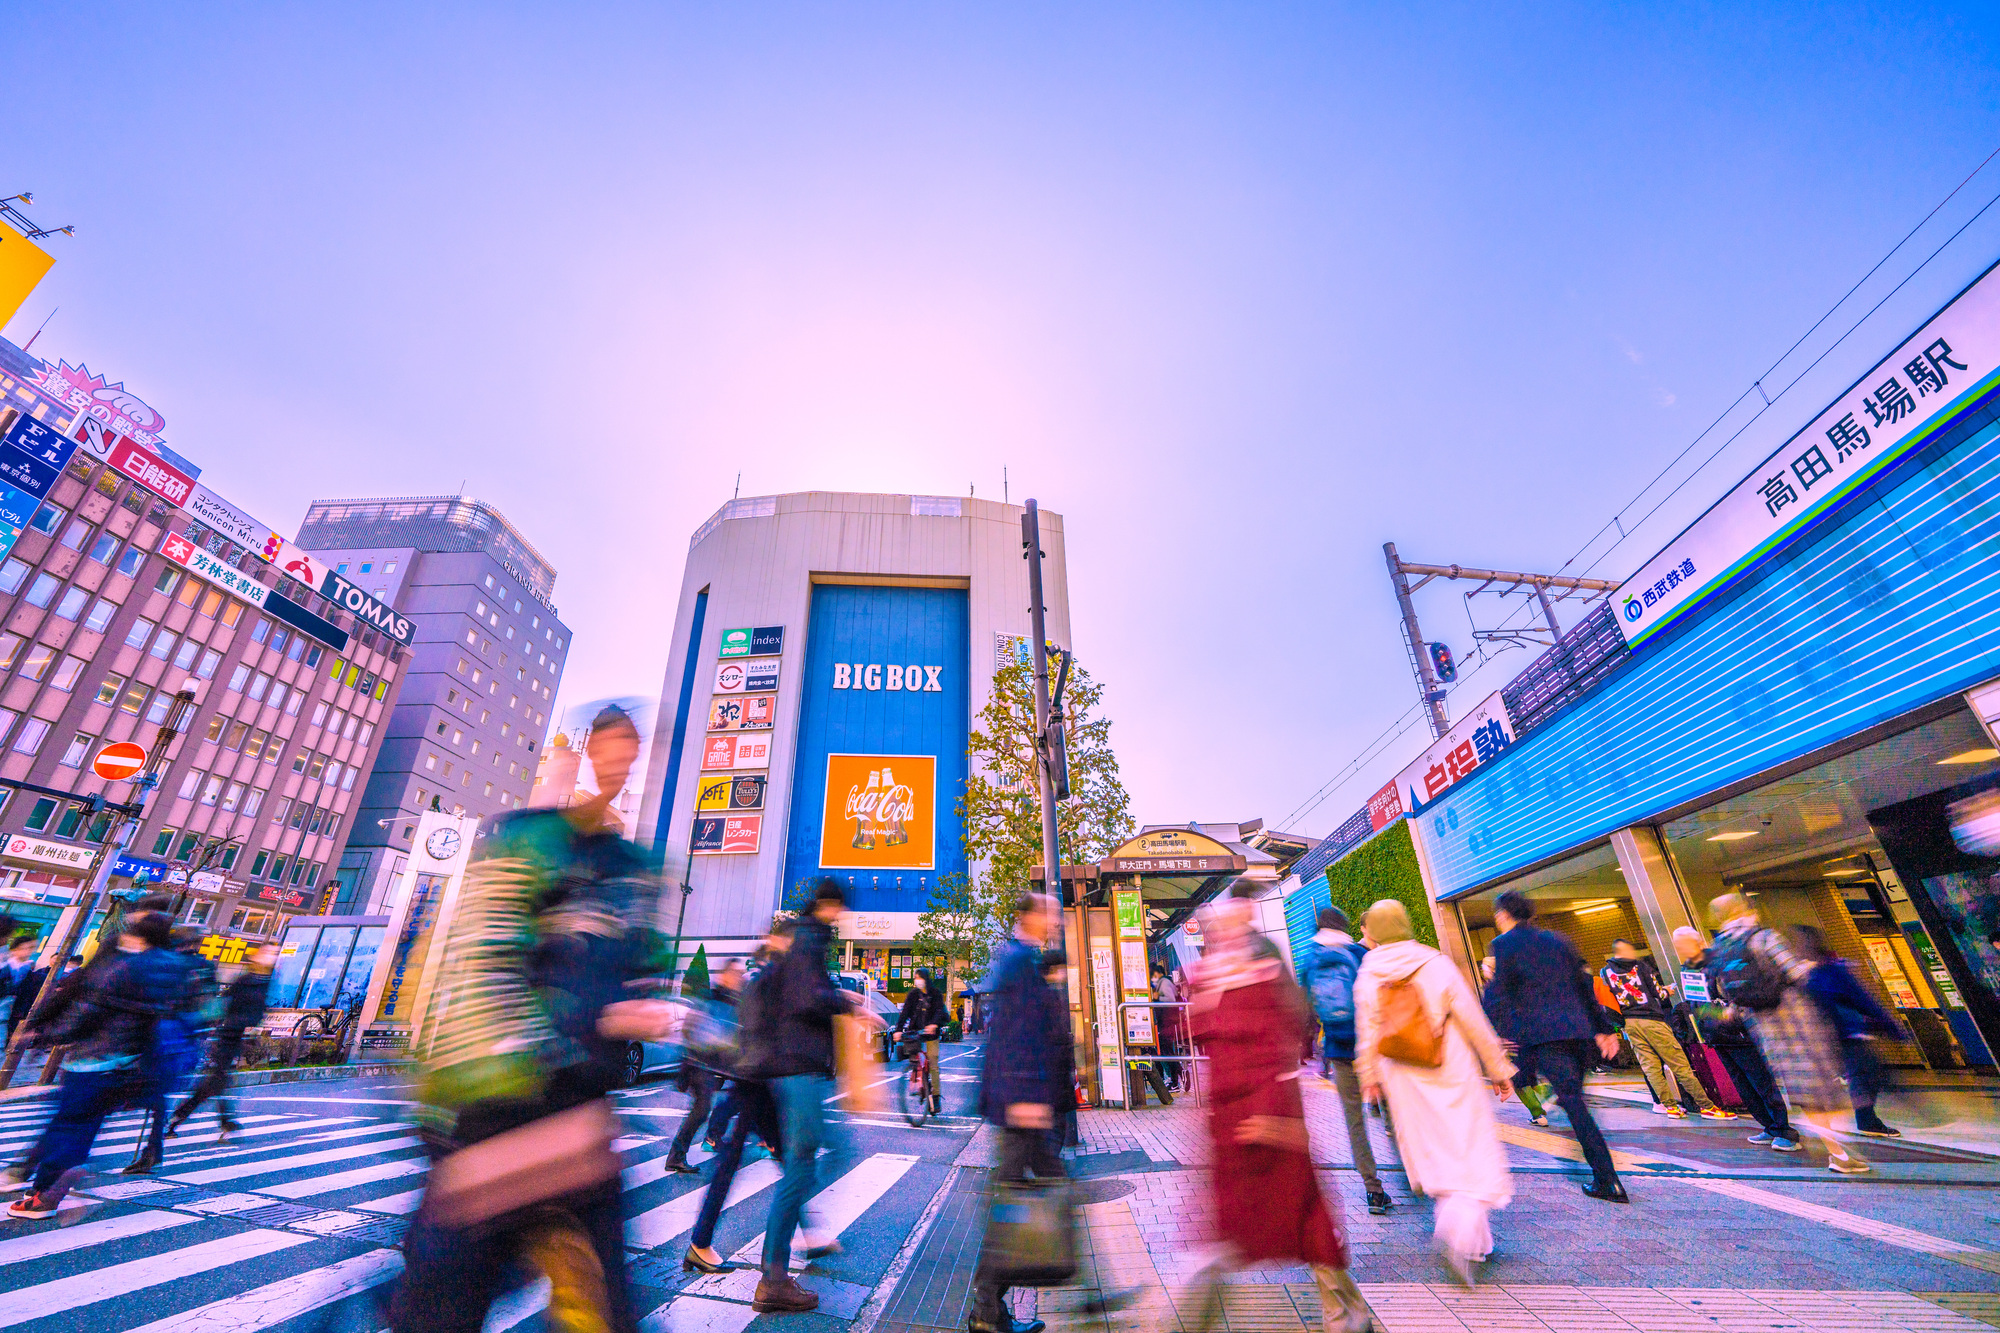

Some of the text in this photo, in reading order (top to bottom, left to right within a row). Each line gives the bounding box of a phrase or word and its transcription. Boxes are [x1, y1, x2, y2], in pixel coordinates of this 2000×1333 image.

[1756, 337, 1968, 518] 高田馬場駅
[123, 451, 188, 502] 日能研
[191, 501, 262, 550] Menicon Miru
[197, 493, 255, 532] コンタクトレンズ
[167, 540, 189, 559] 本
[191, 553, 264, 602] 芳林堂書店
[1642, 558, 1696, 608] 西武鉄道
[328, 577, 409, 640] TOMAS
[753, 635, 781, 645] index
[708, 751, 731, 762] GAME
[845, 784, 914, 822] Coca-Cola
[727, 829, 757, 837] レンタカー
